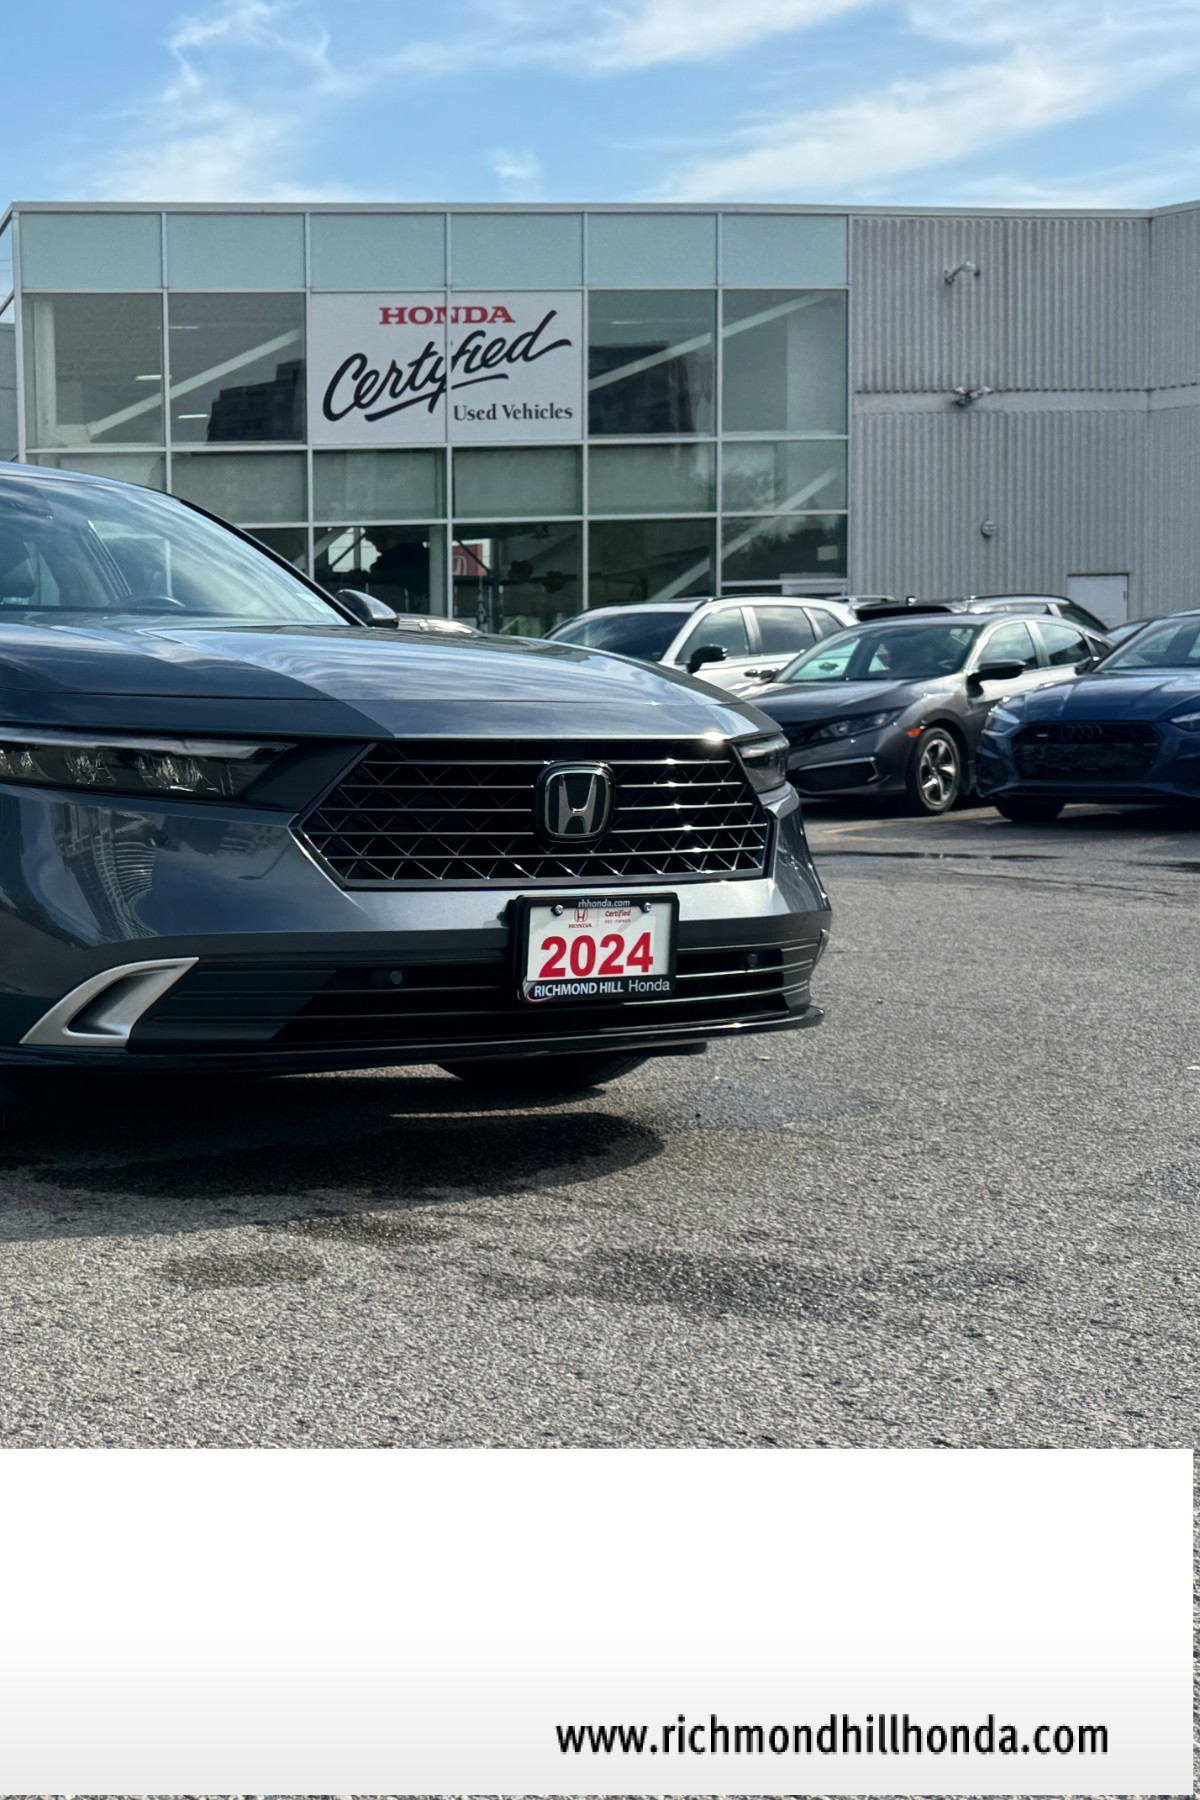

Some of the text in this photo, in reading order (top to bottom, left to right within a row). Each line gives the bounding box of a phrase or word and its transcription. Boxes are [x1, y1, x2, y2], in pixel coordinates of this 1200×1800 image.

[379, 306, 516, 325] HONDA
[322, 310, 572, 422] Certified
[453, 402, 573, 421] Used Vehicles
[578, 899, 631, 908] rhhonda.com
[605, 909, 631, 917] Certified
[539, 932, 654, 979] 2024
[534, 978, 671, 998] RICHMOND HILL Honda
